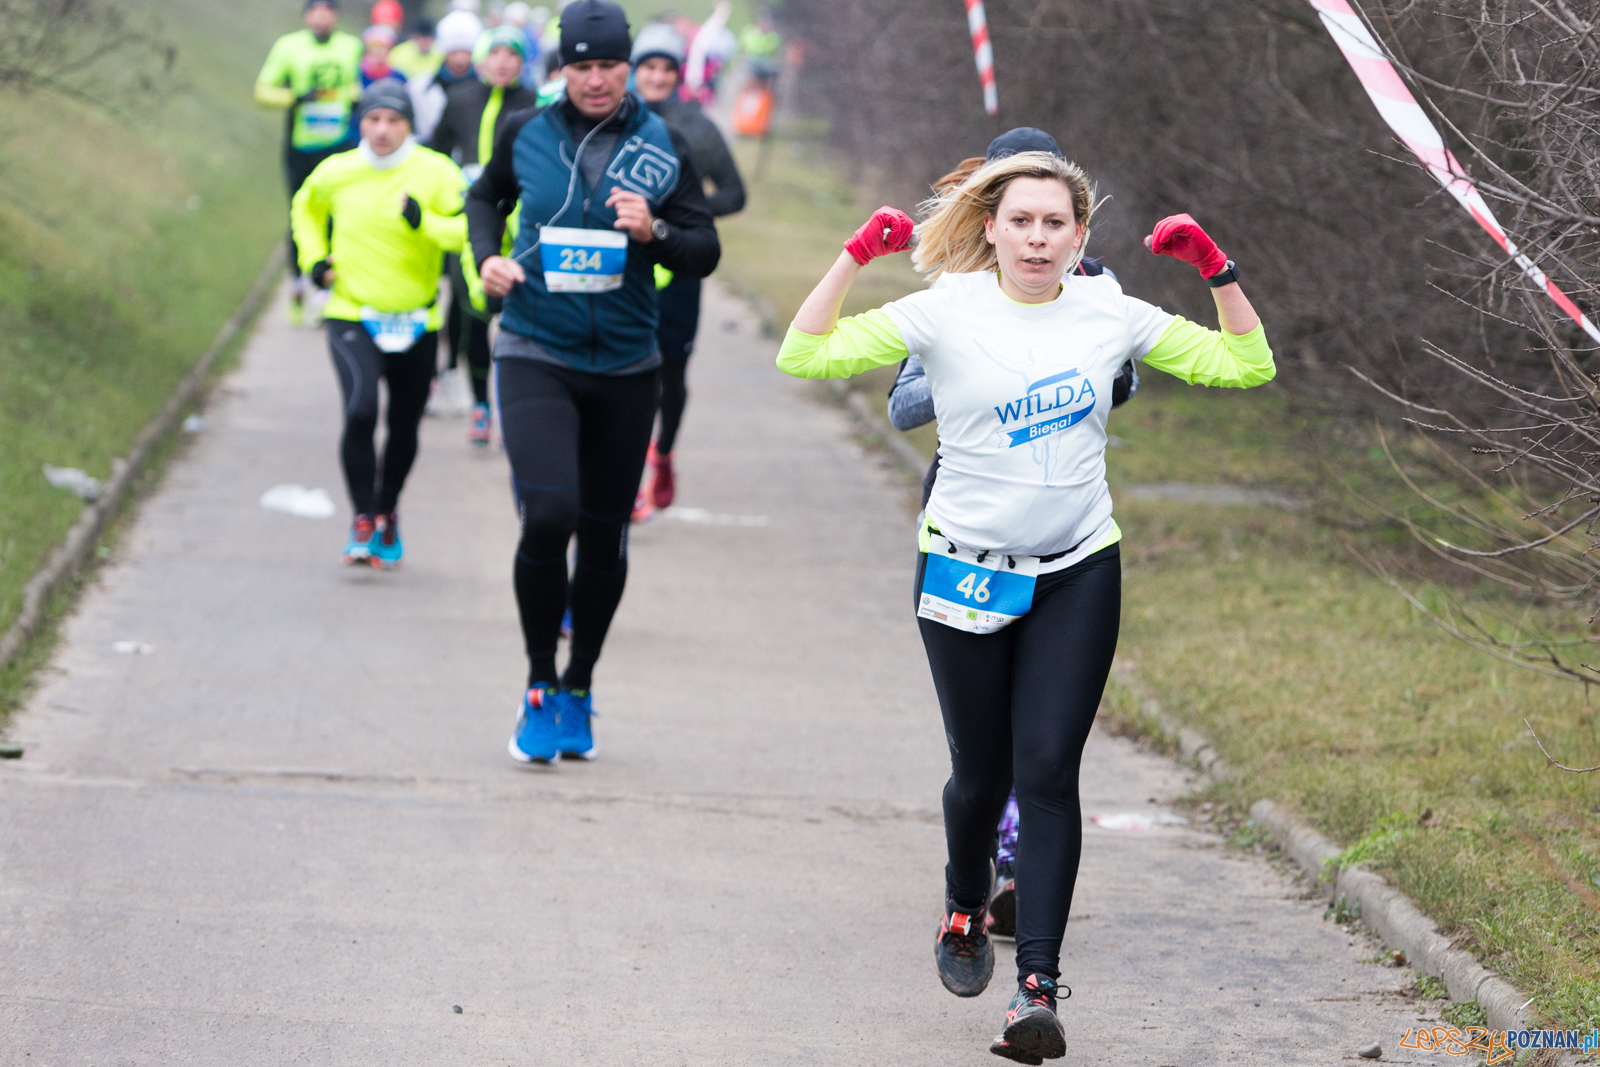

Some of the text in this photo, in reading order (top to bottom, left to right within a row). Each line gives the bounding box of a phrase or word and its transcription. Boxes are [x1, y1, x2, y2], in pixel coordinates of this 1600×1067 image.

[559, 248, 602, 271] 234
[994, 378, 1096, 424] WILDA
[1029, 414, 1071, 438] Biega!
[956, 572, 991, 603] 46
